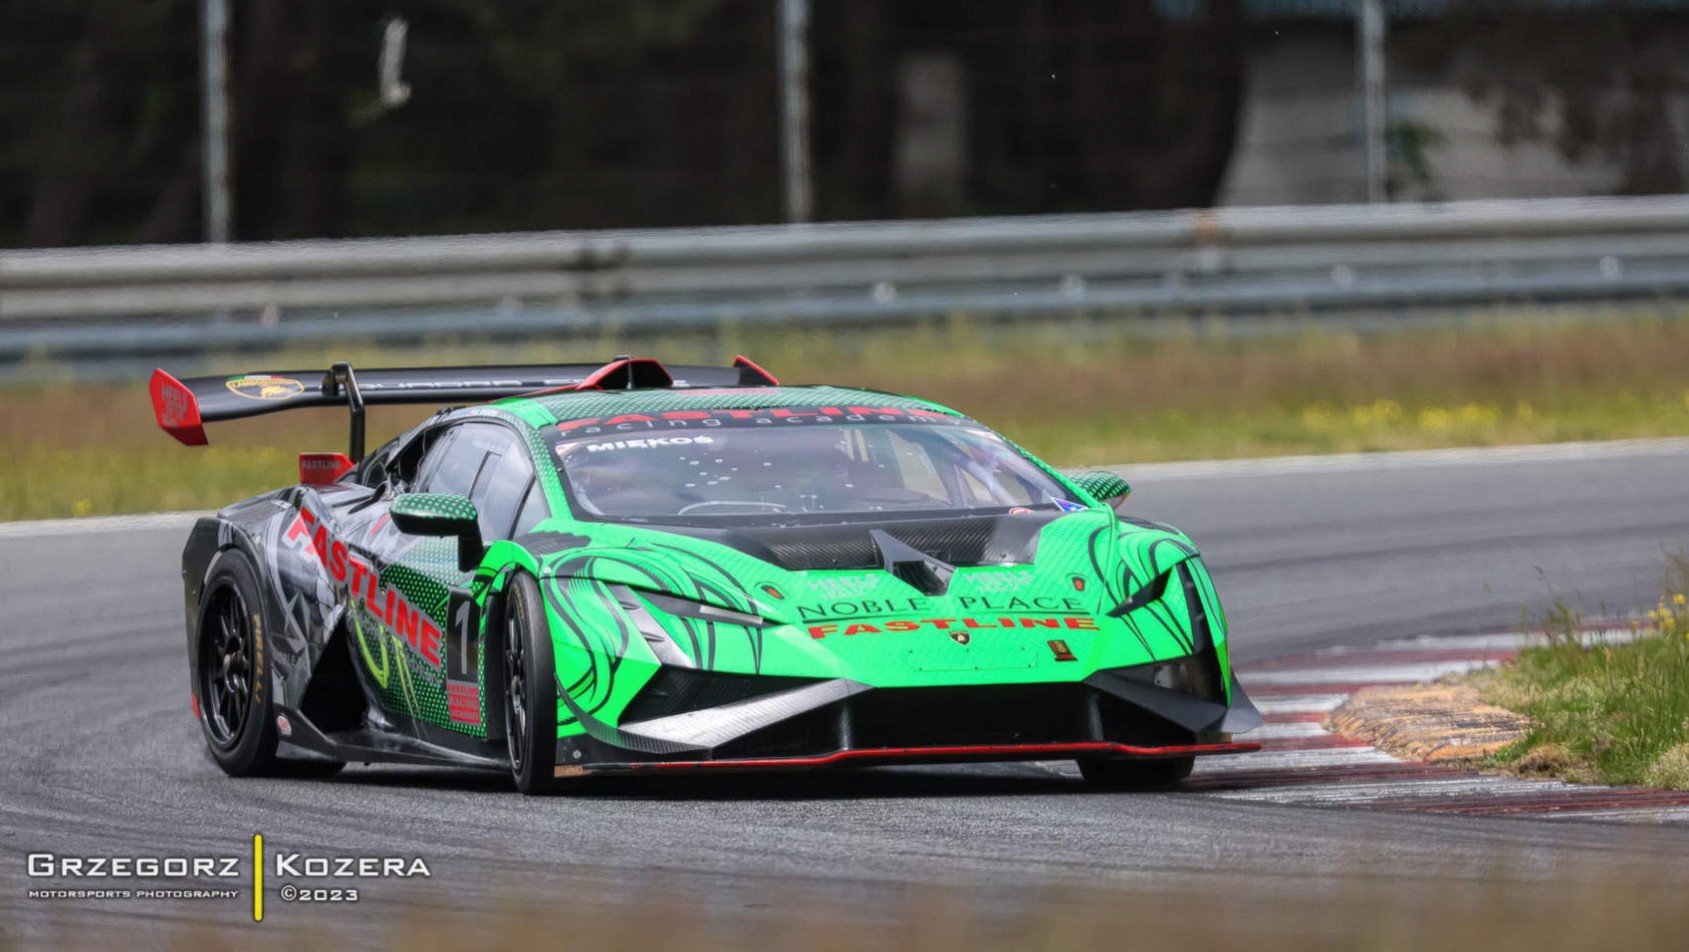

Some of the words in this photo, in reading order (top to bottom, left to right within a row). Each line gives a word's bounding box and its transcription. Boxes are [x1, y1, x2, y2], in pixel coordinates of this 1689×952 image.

[561, 418, 722, 436] racing
[286, 505, 442, 669] FASTLINE
[796, 596, 932, 620] NOBLE
[957, 595, 1090, 611] PLACE
[454, 600, 471, 675] 1
[807, 616, 1101, 640] FASTLINE
